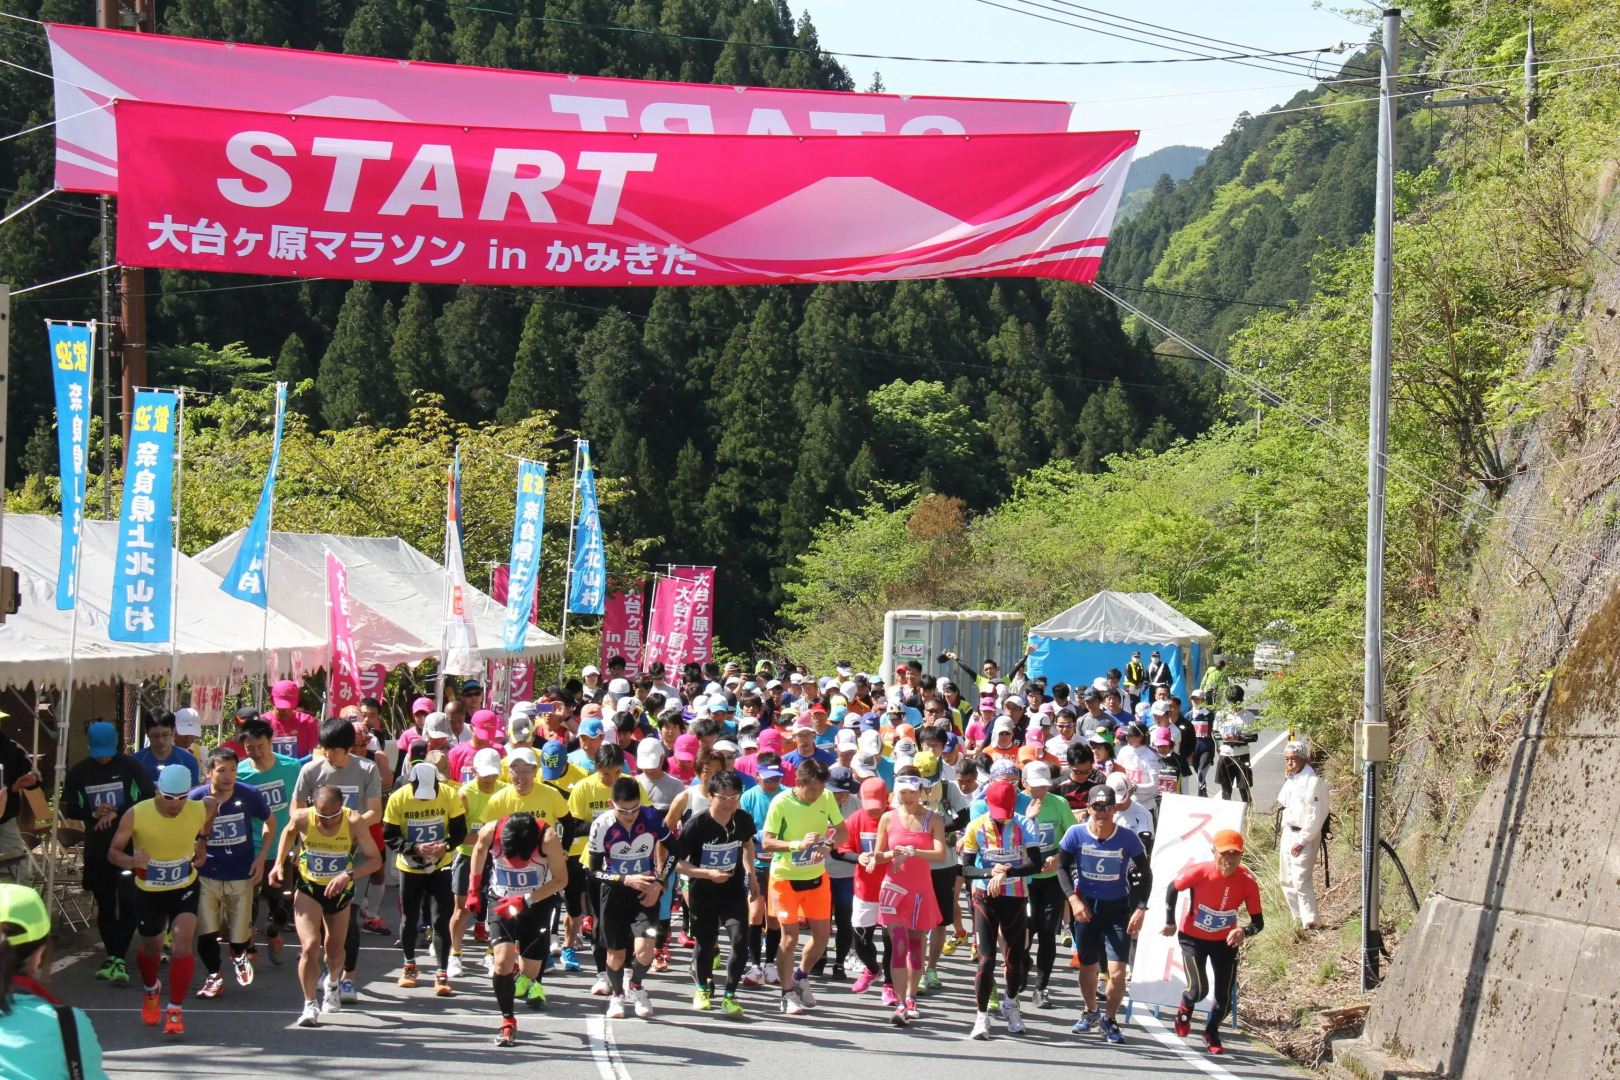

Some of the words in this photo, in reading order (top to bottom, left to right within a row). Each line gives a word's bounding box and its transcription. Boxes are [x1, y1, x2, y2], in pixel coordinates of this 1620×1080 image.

[217, 130, 657, 226] START
[147, 213, 466, 267] 大台ヶ原マラソン
[488, 238, 526, 270] in
[545, 239, 697, 276] かみきた
[606, 631, 621, 643] in
[901, 643, 922, 653] トイレ
[213, 823, 237, 839] 53
[415, 825, 438, 843] 25
[314, 857, 338, 872] 86
[709, 850, 731, 866] 56
[1095, 858, 1105, 873] 6
[155, 866, 181, 881] 30
[619, 859, 642, 874] 64
[505, 872, 527, 888] 10
[1203, 914, 1227, 928] 83
